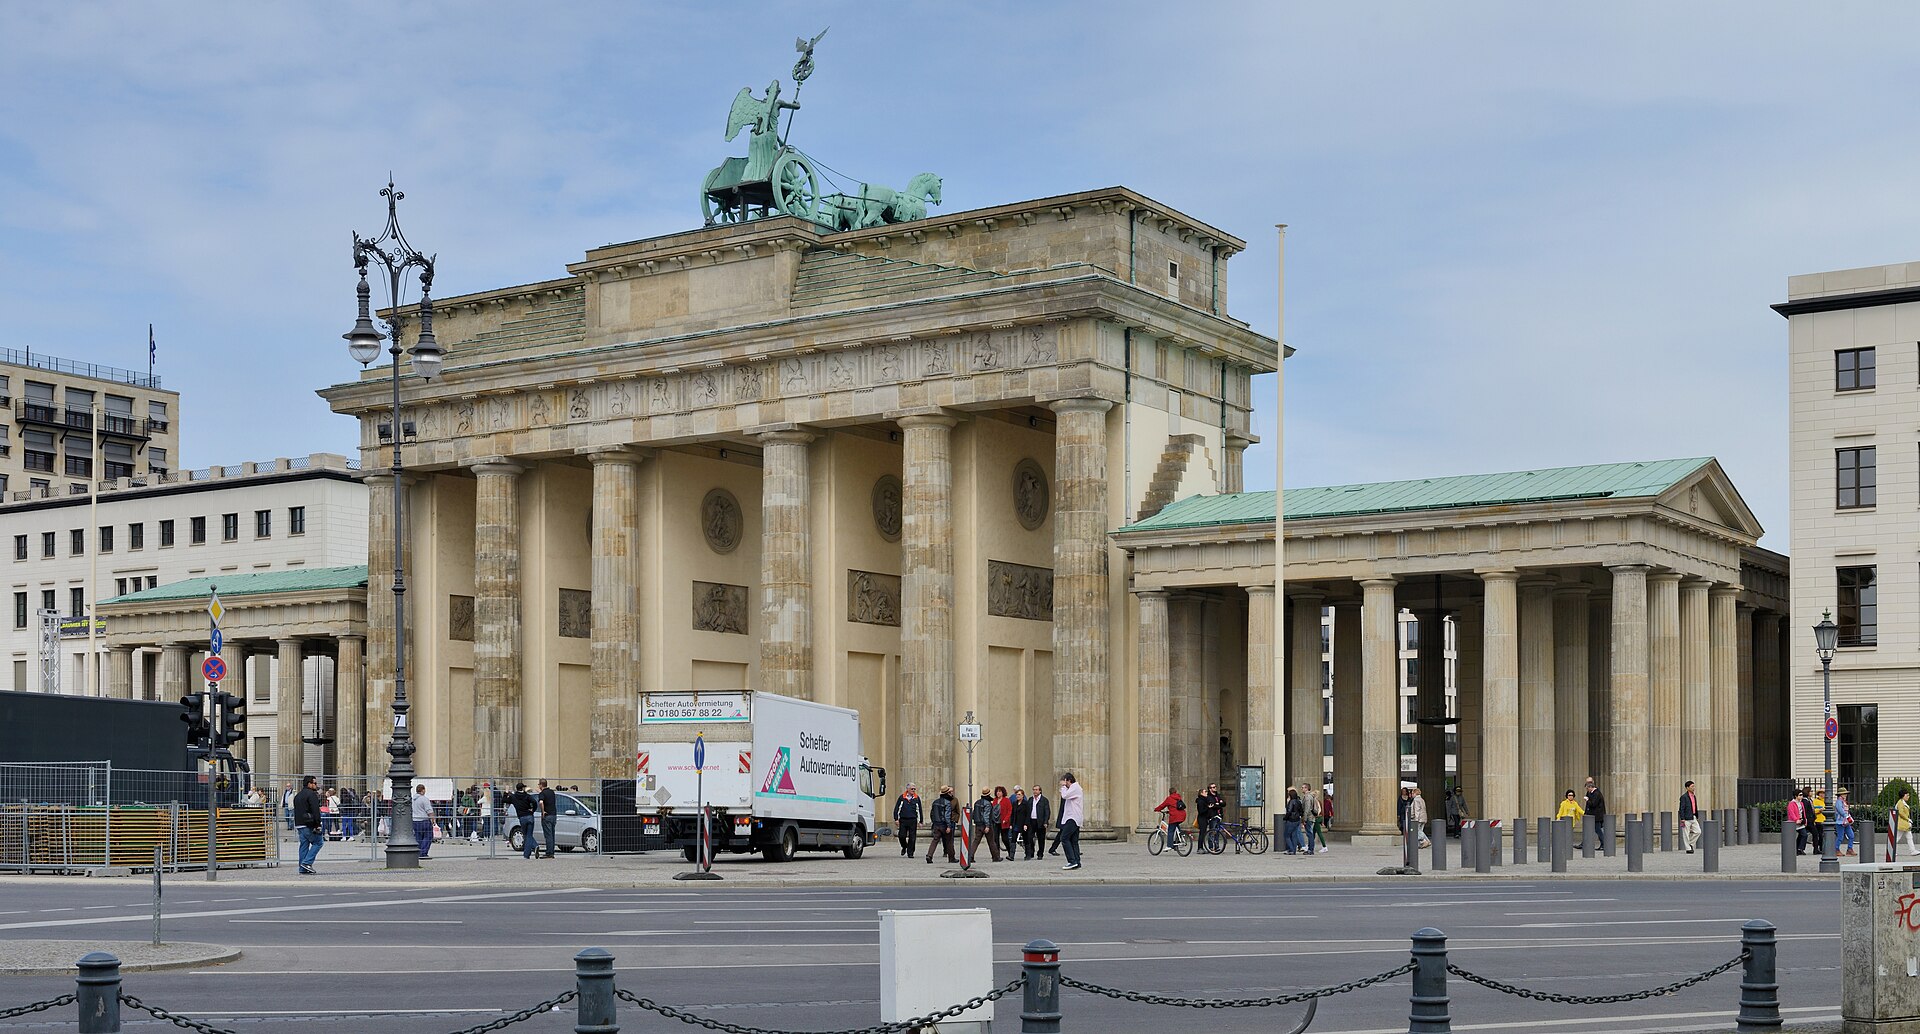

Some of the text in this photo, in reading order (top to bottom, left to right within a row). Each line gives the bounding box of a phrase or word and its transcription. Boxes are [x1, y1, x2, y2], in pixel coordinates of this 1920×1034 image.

[1824, 702, 1830, 712] 5
[659, 709, 722, 717] 0180 567 88 22
[395, 715, 401, 726] 7
[799, 731, 831, 752] Schefter
[799, 755, 856, 782] Autovermietung
